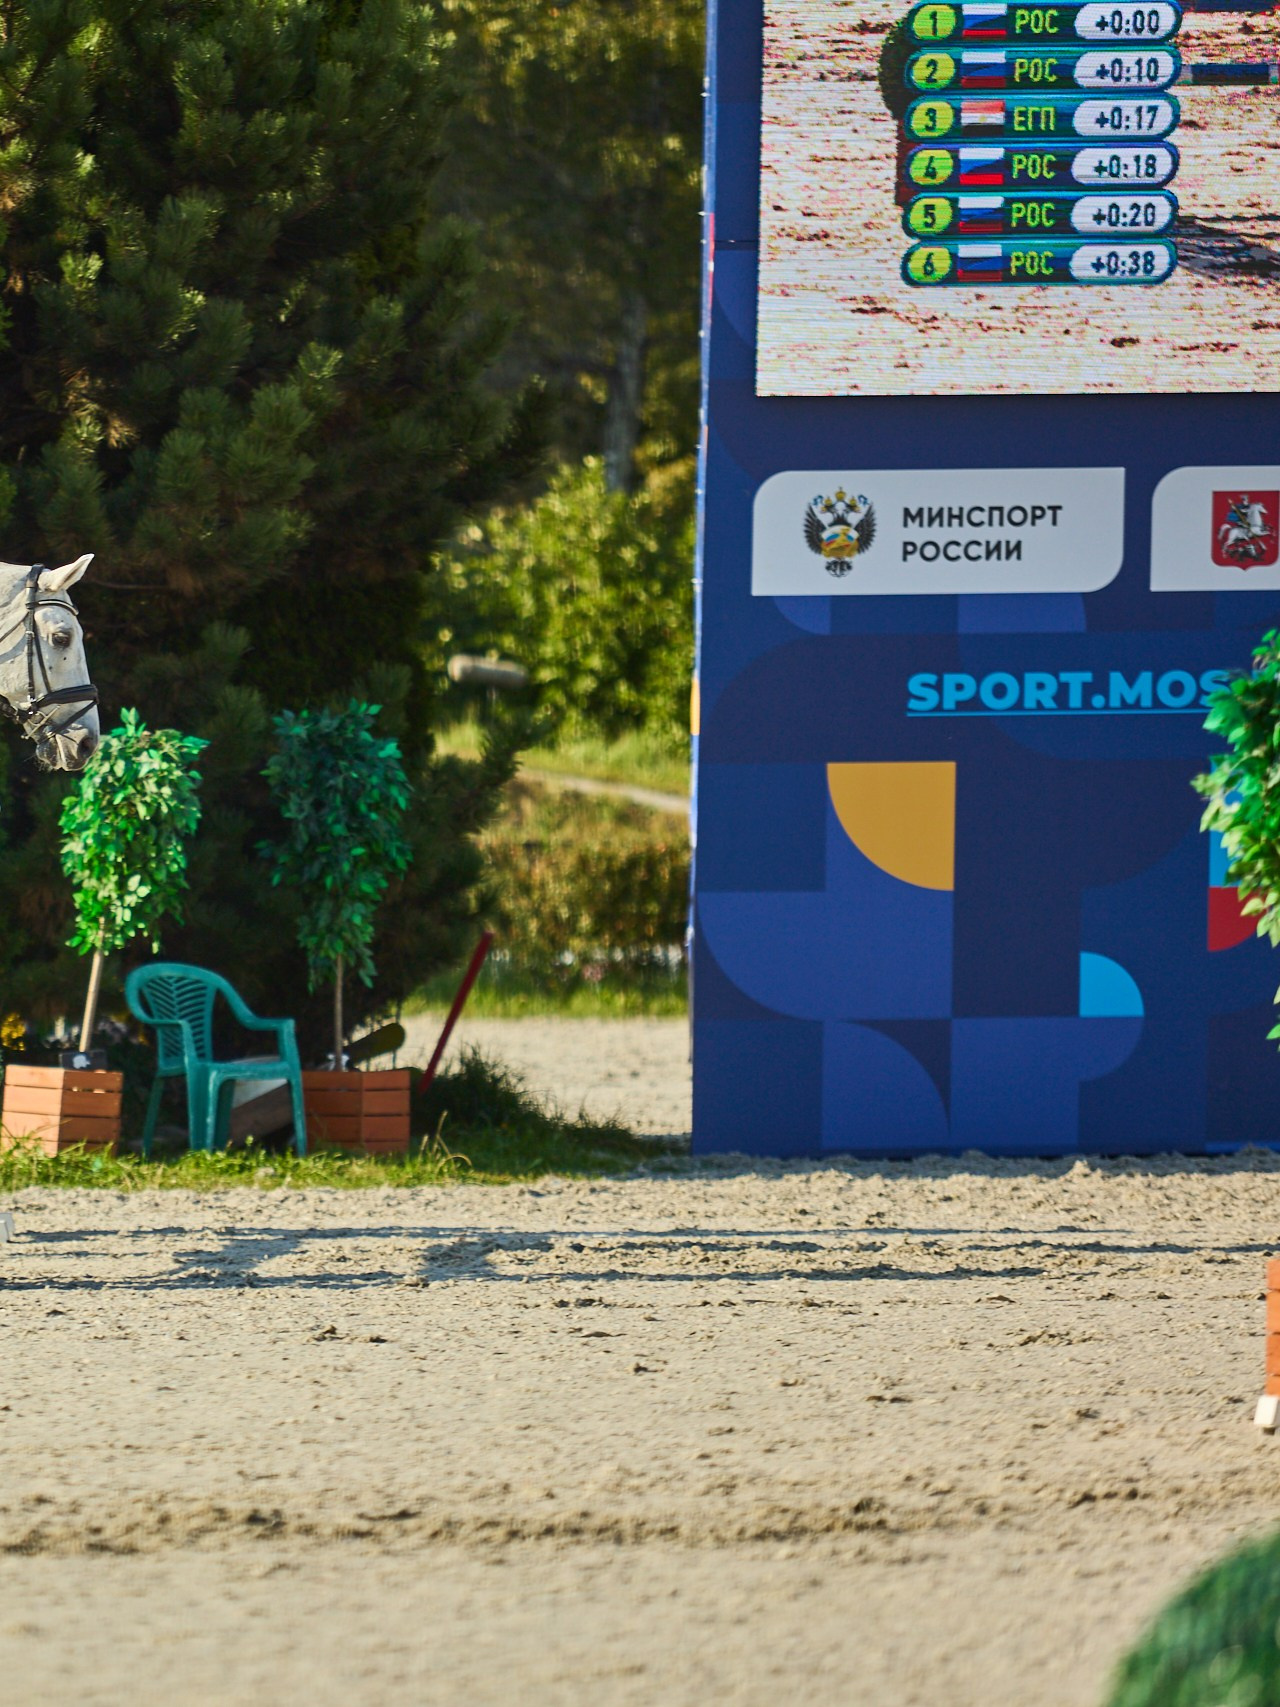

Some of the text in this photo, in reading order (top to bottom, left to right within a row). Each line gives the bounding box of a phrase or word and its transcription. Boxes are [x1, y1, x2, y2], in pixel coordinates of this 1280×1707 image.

[930, 9, 1160, 36] 1 РОС +0:00
[926, 58, 1160, 84] 2 РОС +0:10
[925, 105, 1160, 131] 3 ЕГП +0:17
[924, 154, 1157, 180] 4 РОС +0:18
[923, 202, 1156, 228] 5 РОС +0:20
[923, 250, 1155, 276] 6 РОС +0:38
[902, 505, 1063, 528] МИНСПОРТ
[902, 540, 1023, 562] РОССИИ
[907, 669, 1232, 711] SPORT.MOS
